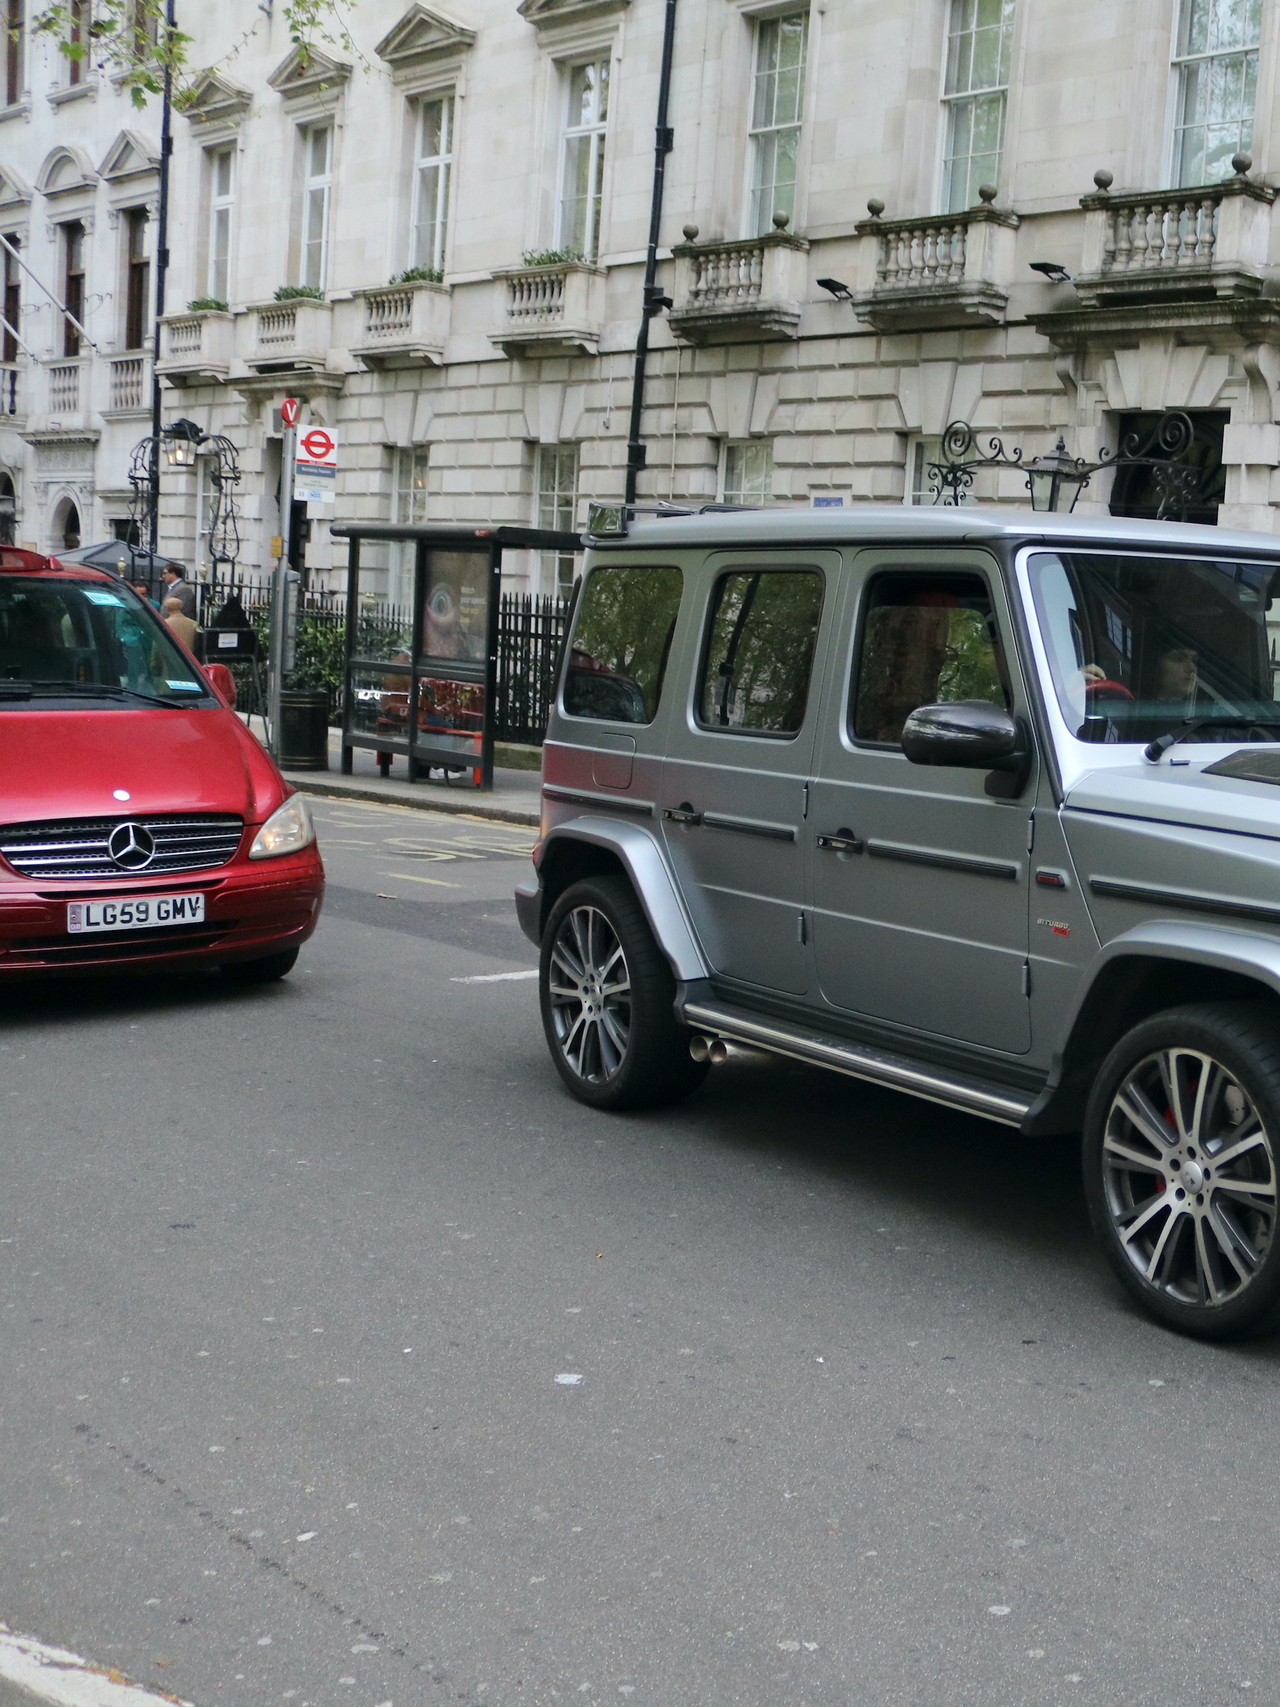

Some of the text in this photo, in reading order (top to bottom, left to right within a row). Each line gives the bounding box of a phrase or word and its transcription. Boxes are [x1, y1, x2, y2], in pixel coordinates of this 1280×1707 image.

[286, 403, 297, 422] V
[86, 896, 200, 927] LG59 GMV
